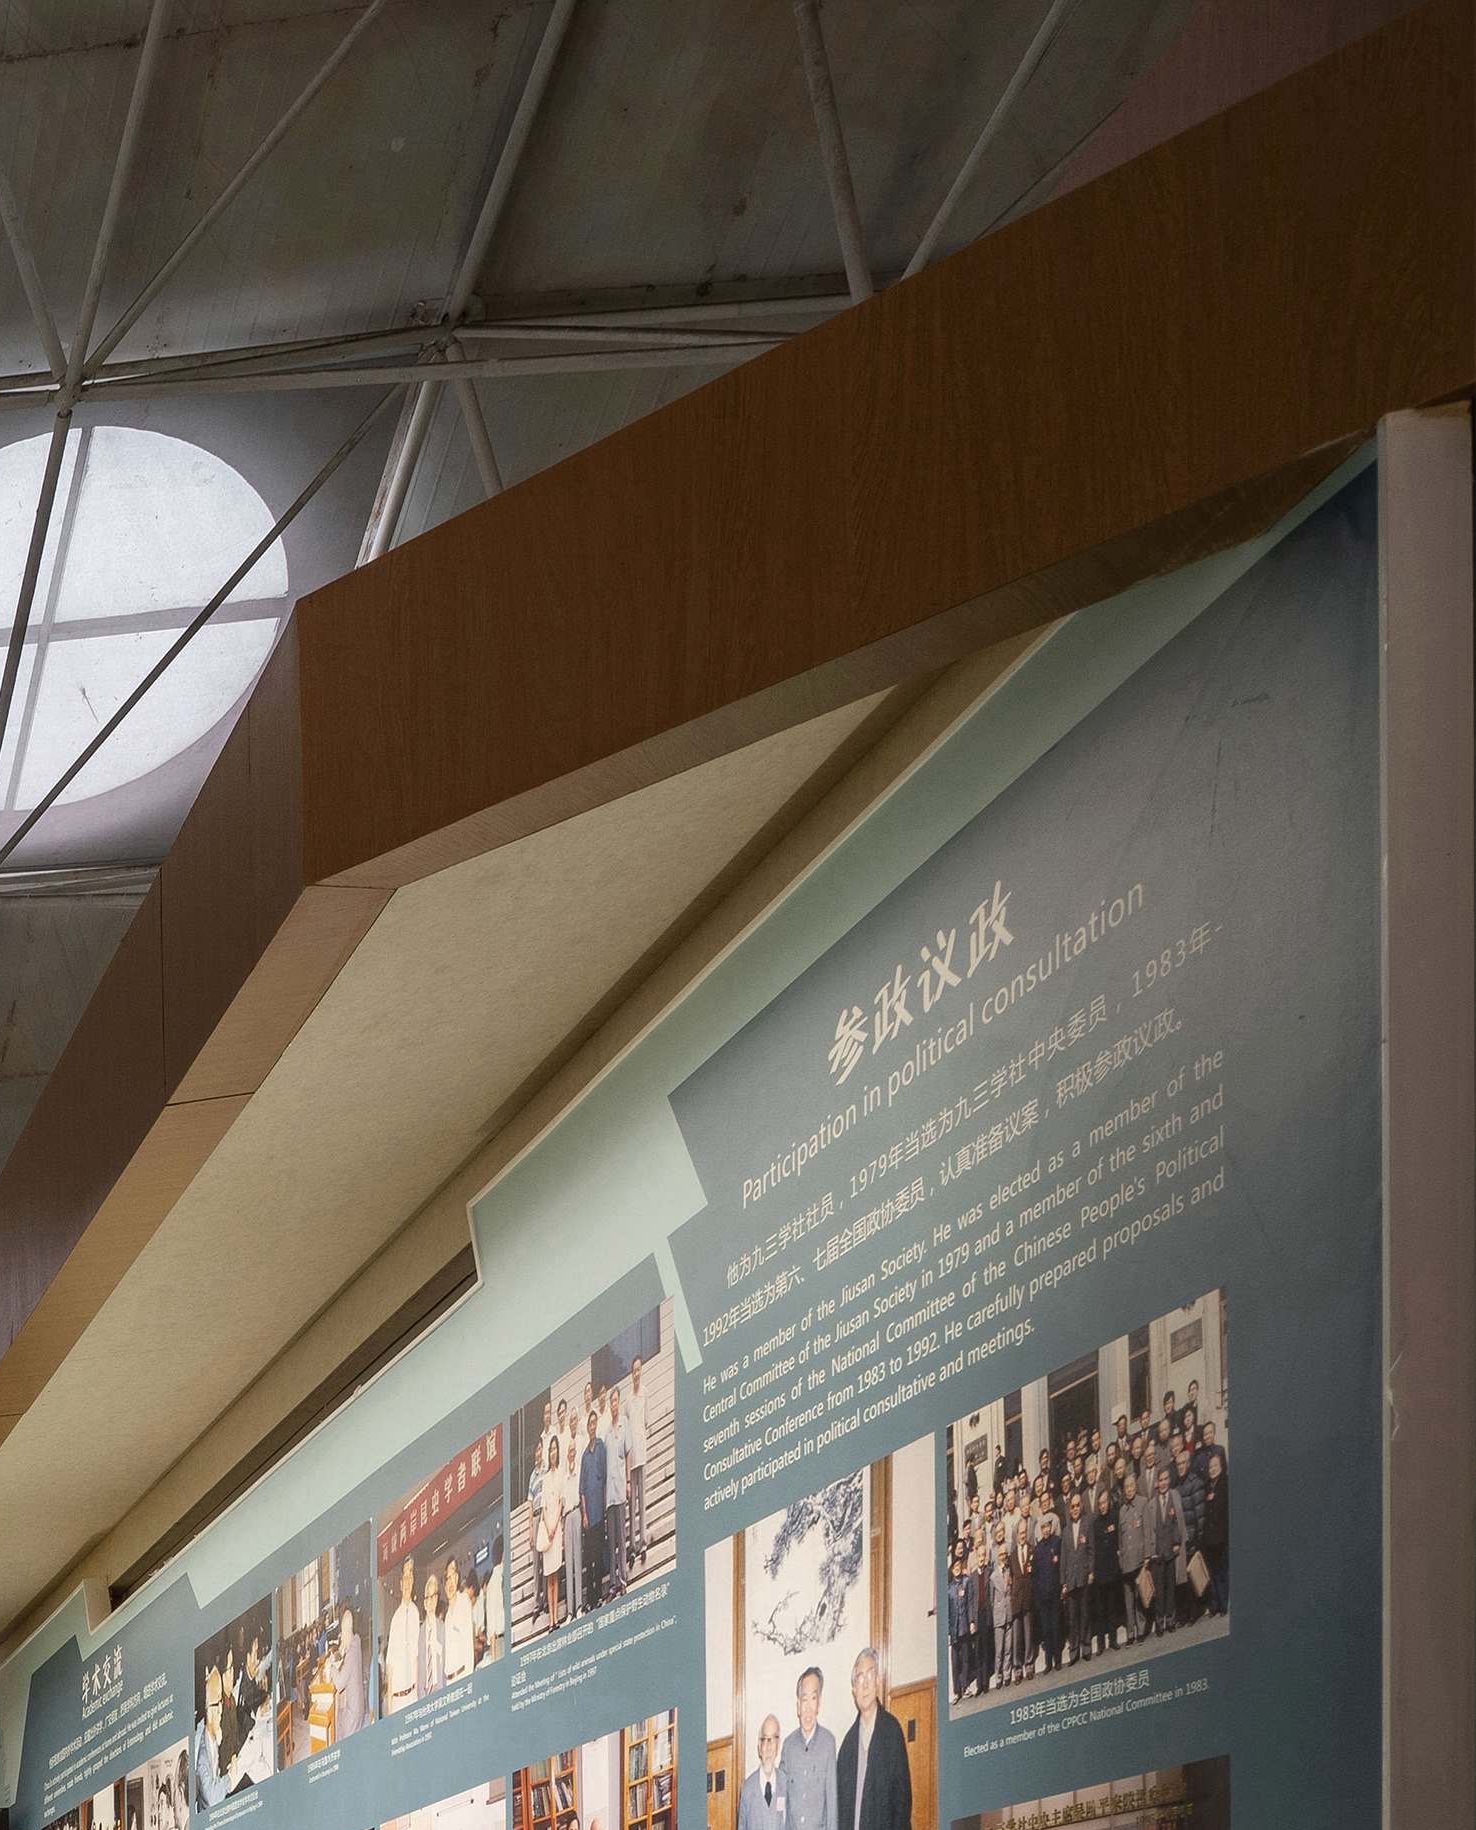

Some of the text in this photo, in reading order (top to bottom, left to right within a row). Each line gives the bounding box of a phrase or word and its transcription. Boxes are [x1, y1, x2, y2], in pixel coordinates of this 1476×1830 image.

[744, 884, 1142, 1208] Participation in political consultation
[828, 881, 1014, 1085] 参政议政
[703, 1084, 1222, 1422] Central Committee of the Jiusan Society in 1979 and a member of the sixth and
[704, 1051, 1222, 1394] He was a member of the Jiusan Society. He was elected as a member of the
[704, 1125, 1223, 1452] seventh sessions of the National Committee of the Chinese People's Political
[704, 1167, 1223, 1480] Consultative Conference from 1983 to 1992. He carefully prepared proposals and
[705, 1319, 1034, 1510] actively participated in political consultative and meetings.
[964, 1678, 1210, 1757] Elected as a member of the CPPCC National Committee in 1983.
[1010, 1669, 1150, 1725] 1983年当选为全国政协委员
